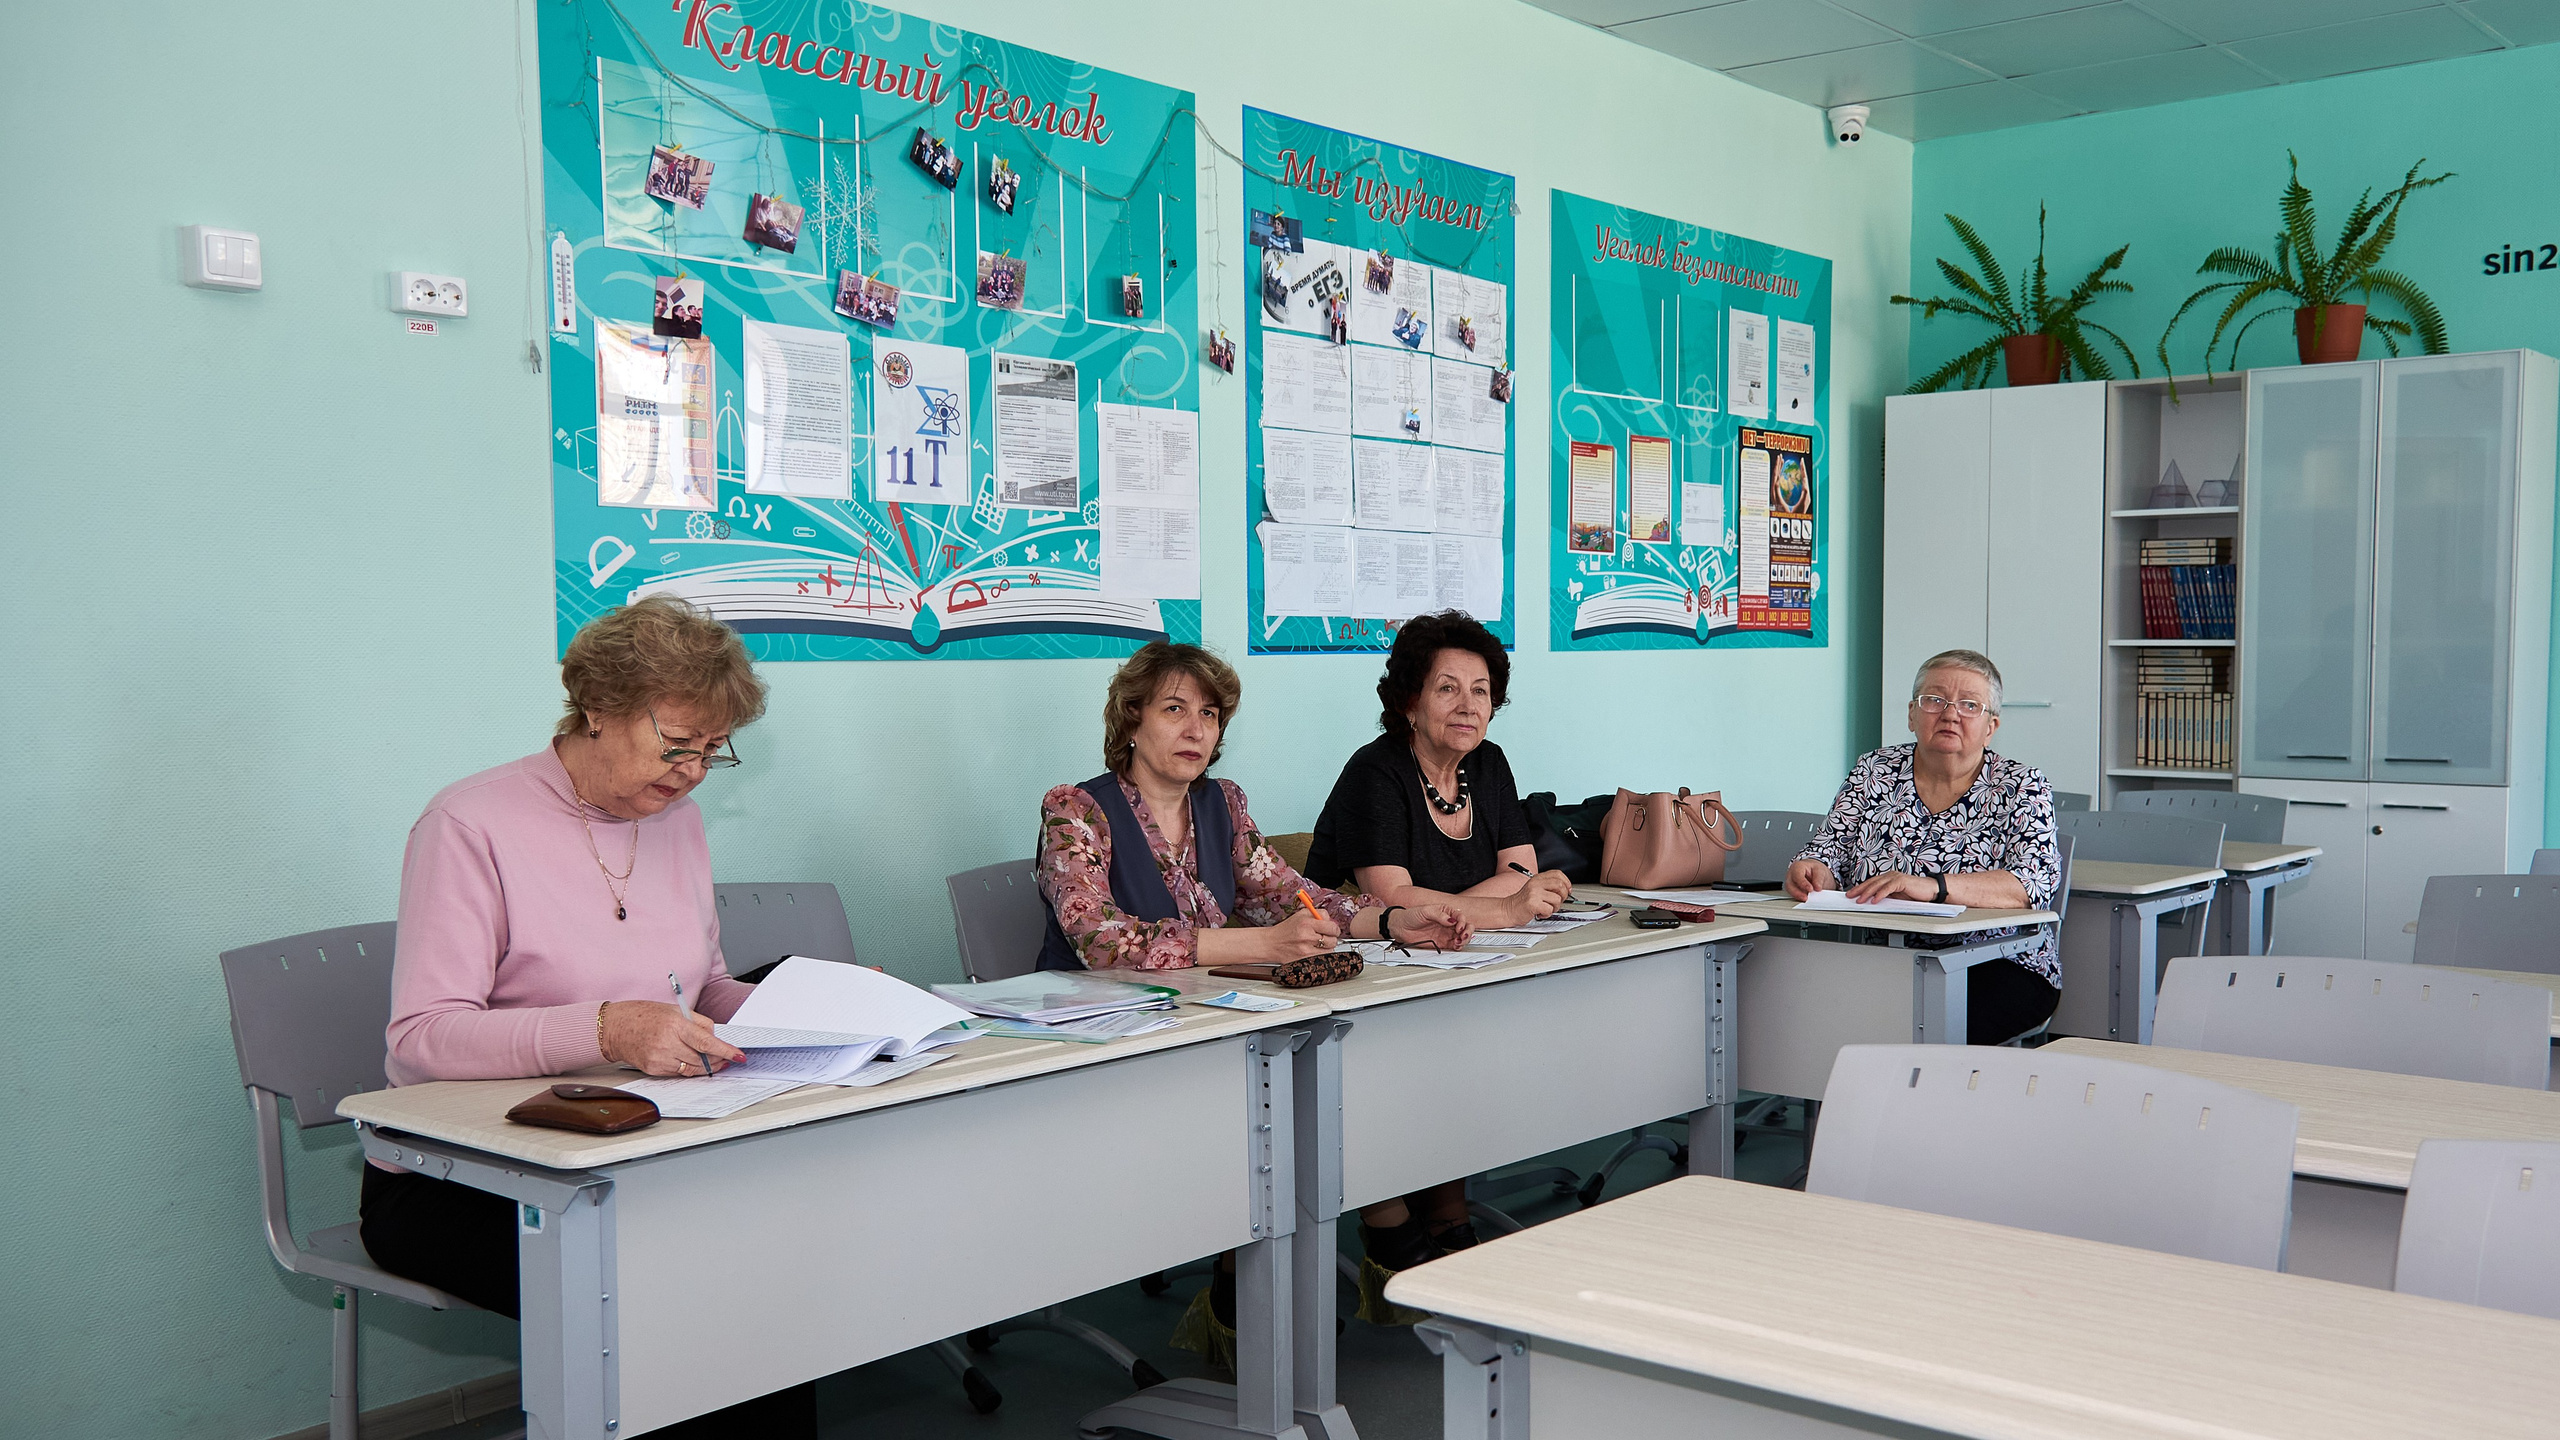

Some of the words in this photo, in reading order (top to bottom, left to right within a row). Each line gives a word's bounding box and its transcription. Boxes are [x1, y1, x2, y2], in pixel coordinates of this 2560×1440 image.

[672, 0, 951, 106] Классный
[955, 80, 1114, 146] уголок
[1277, 148, 1348, 199] Мы
[1354, 176, 1488, 232] изучаем
[1290, 274, 1312, 294] ВРЕМЯ
[1312, 260, 1335, 281] ДУМАТЬ
[1593, 224, 1668, 269] Уголок
[1672, 240, 1801, 299] безопасности
[2483, 244, 2560, 276] sin2
[1312, 269, 1344, 304] ЕГЭ
[410, 322, 434, 332] 220В
[1743, 429, 1757, 447] НЕТ
[887, 446, 917, 485] 11
[925, 439, 948, 487] Т
